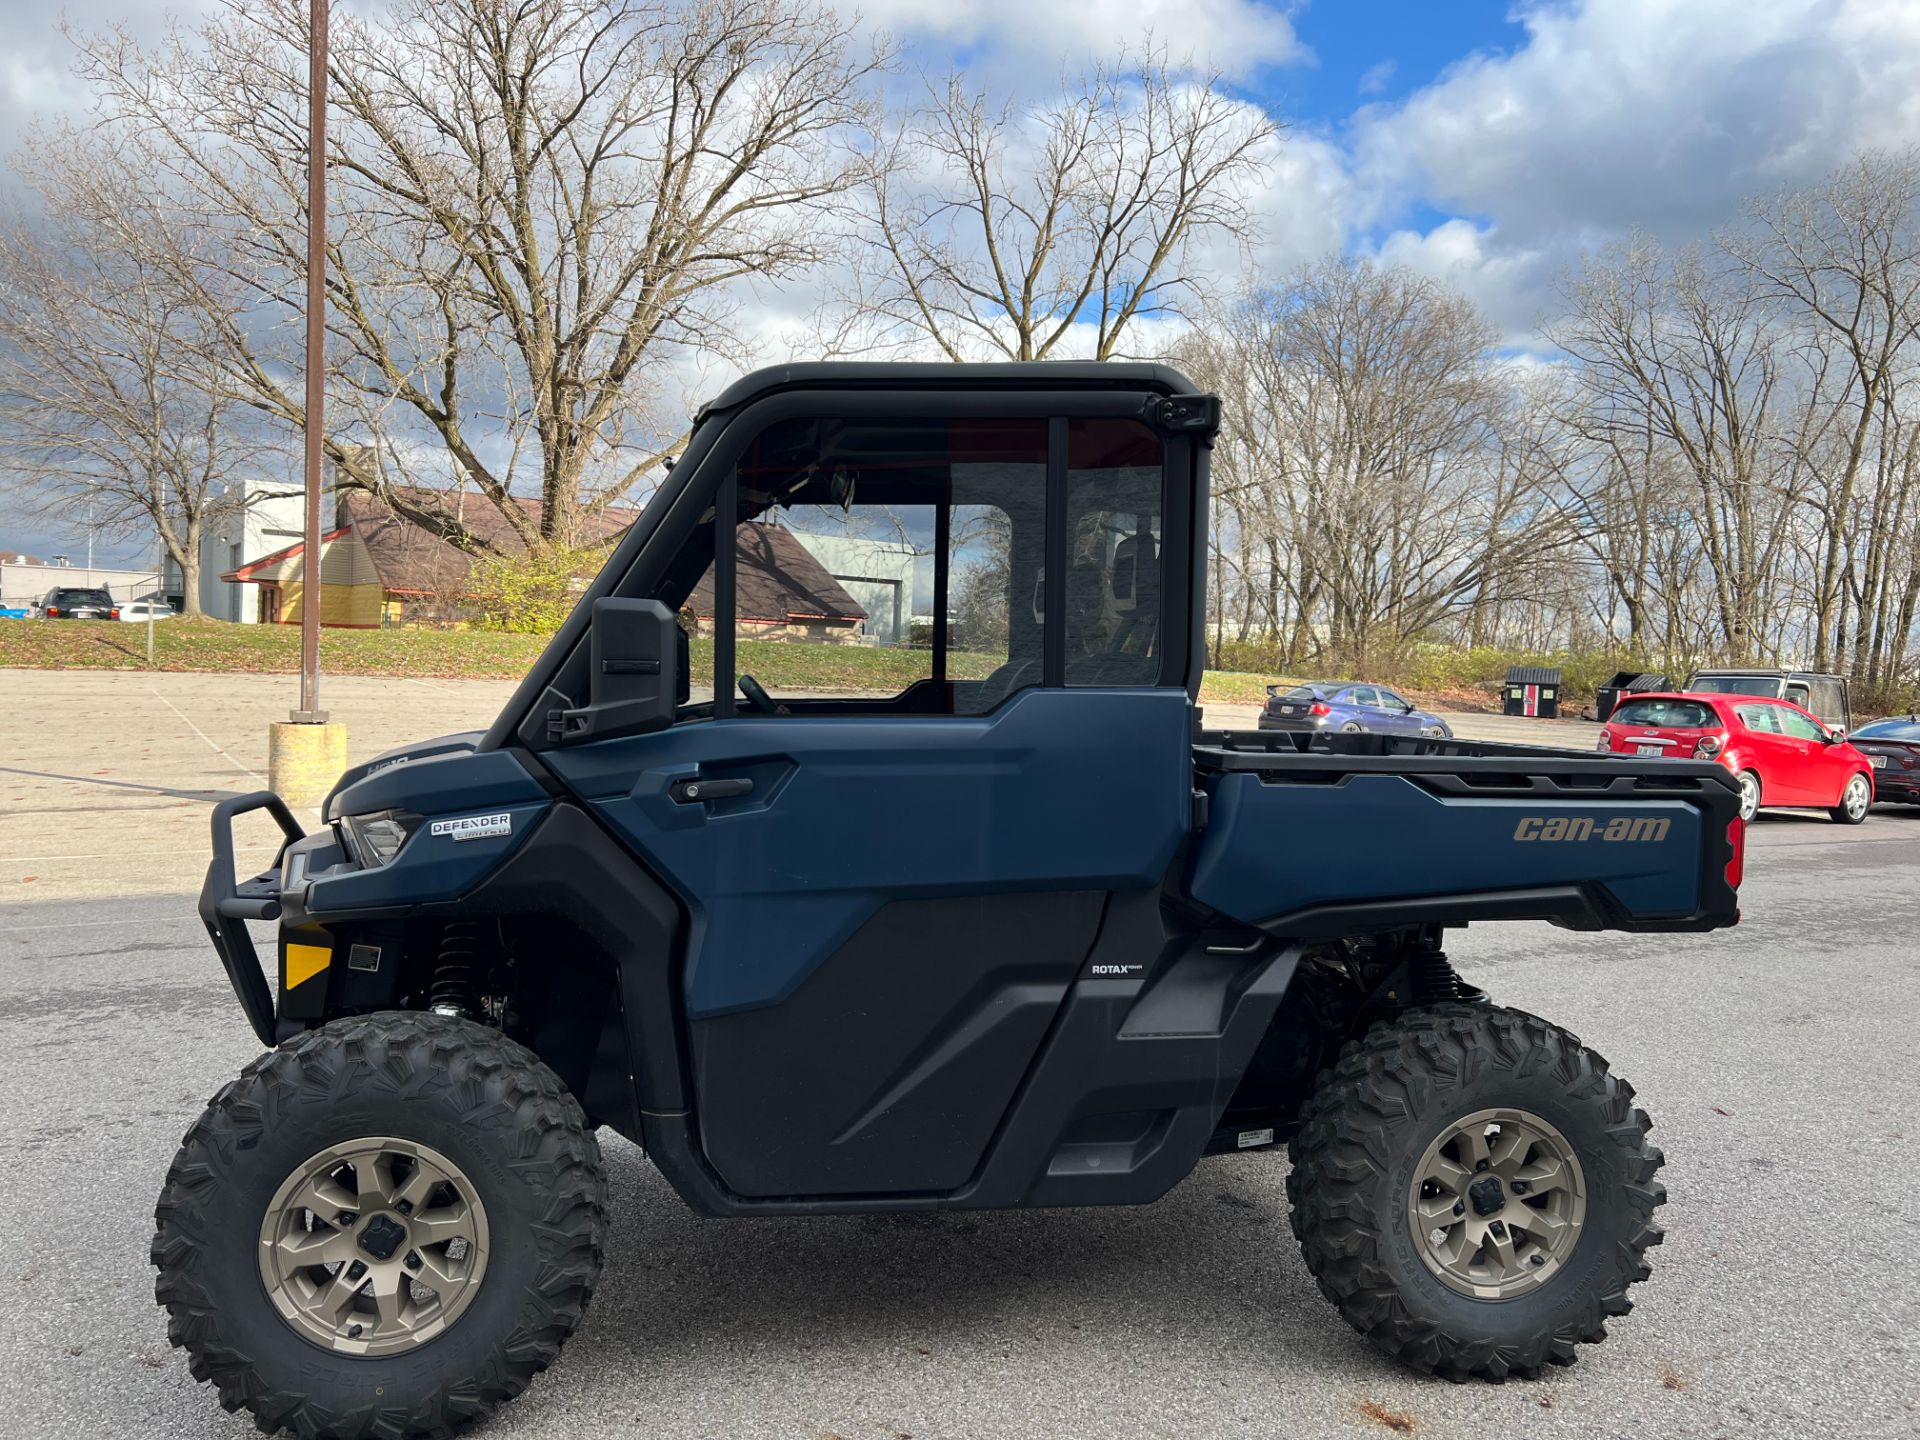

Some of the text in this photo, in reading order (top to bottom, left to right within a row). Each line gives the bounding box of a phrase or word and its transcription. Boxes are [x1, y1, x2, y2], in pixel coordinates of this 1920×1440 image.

[433, 815, 508, 833] DEFENDER
[1513, 817, 1671, 841] can-am
[1092, 965, 1128, 974] ROTAX
